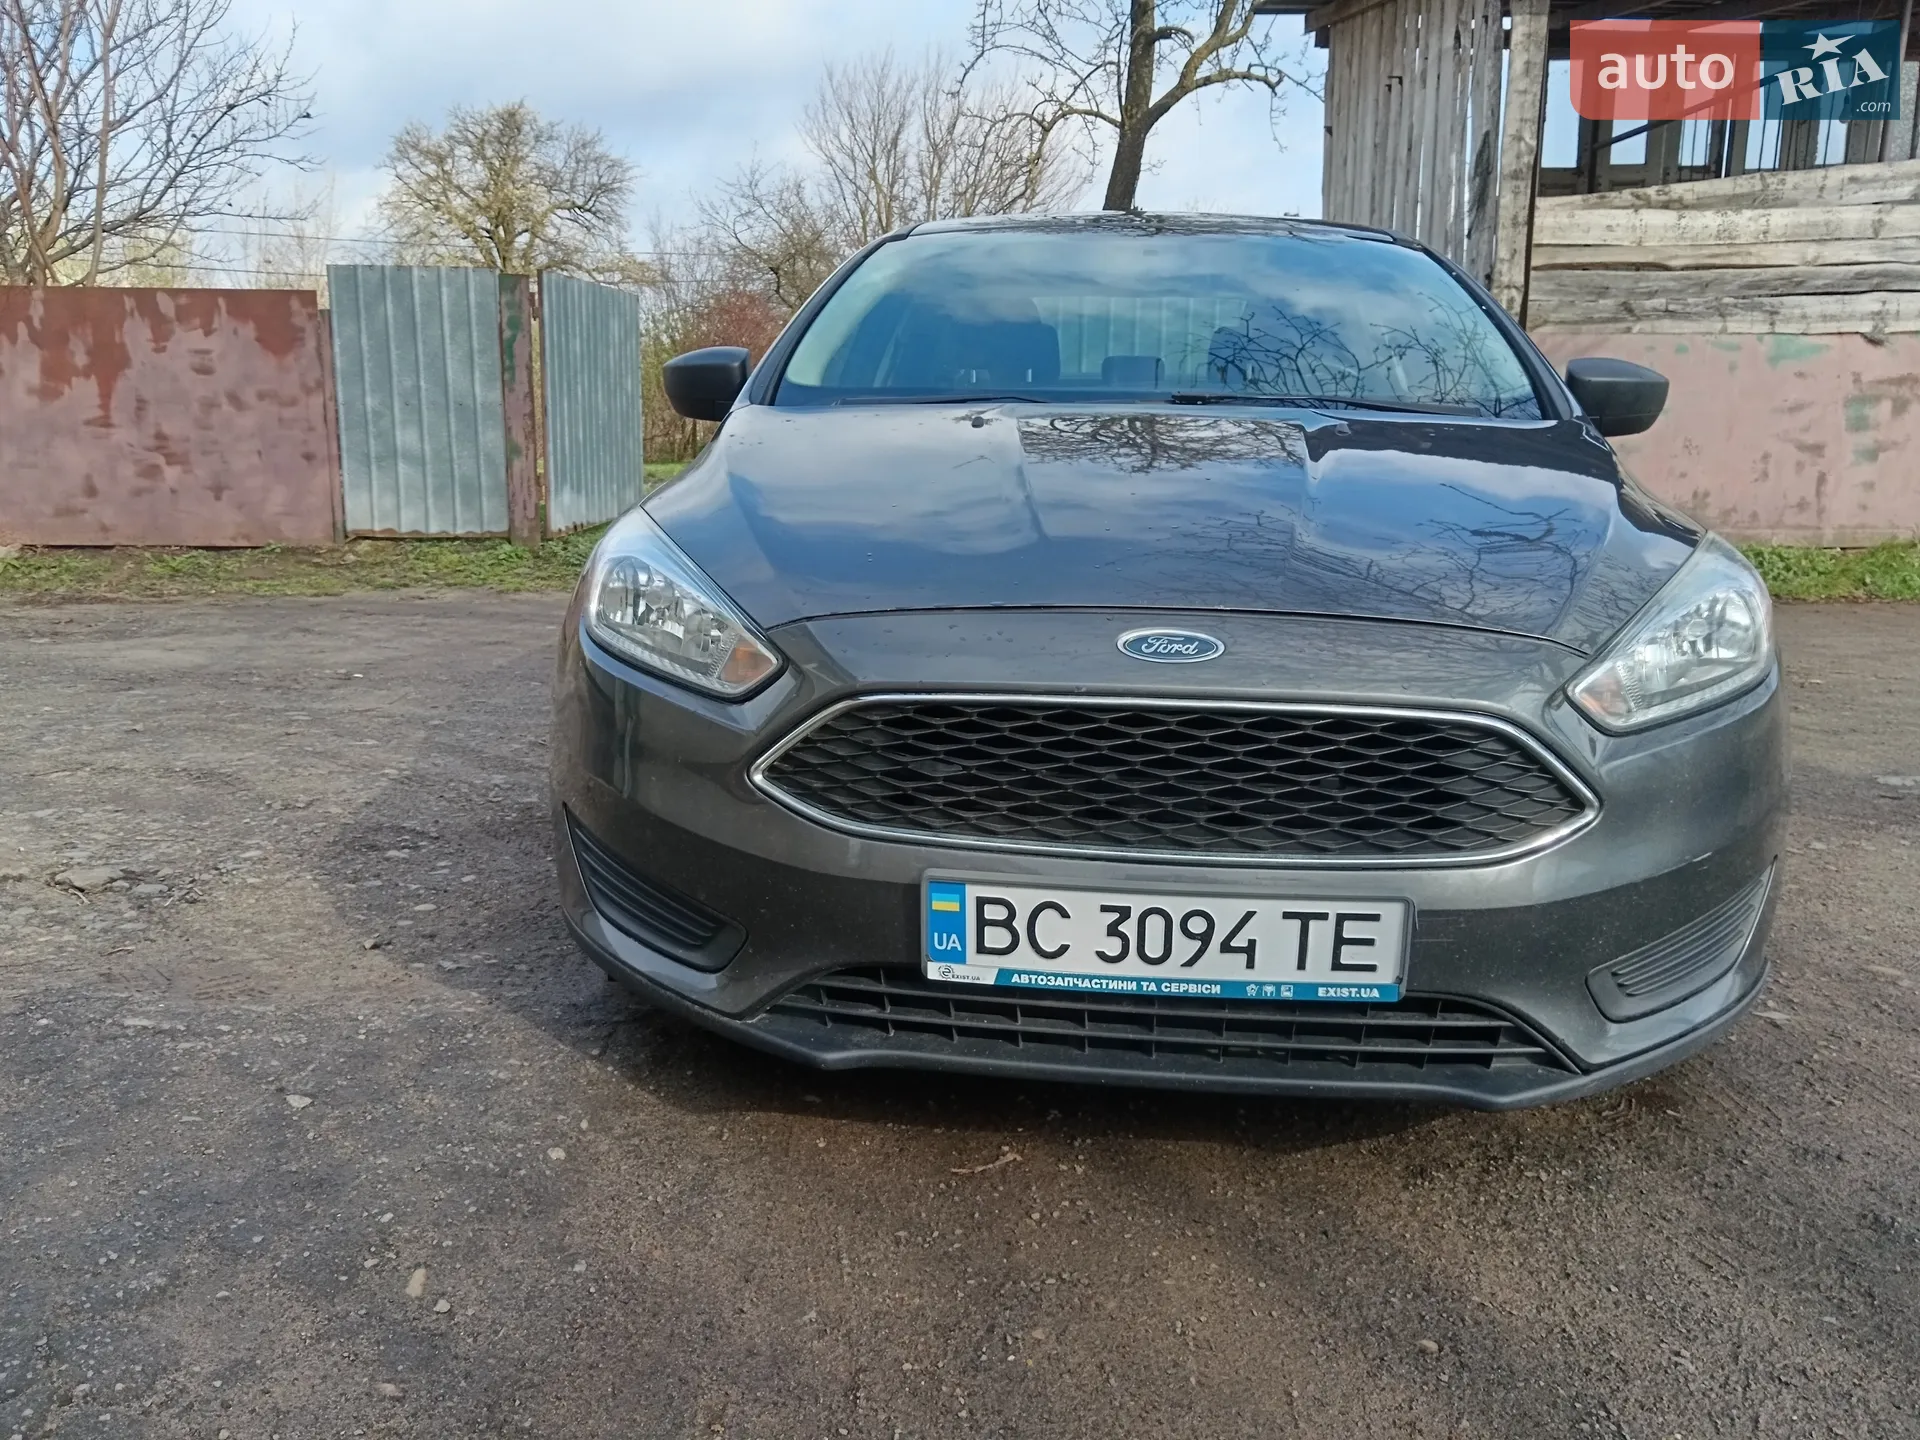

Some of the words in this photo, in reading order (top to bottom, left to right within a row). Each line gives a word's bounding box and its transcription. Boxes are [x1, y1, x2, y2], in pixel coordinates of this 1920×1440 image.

[1141, 636, 1199, 655] Ford
[933, 932, 962, 951] UA
[975, 895, 1071, 960] BC
[1095, 903, 1258, 970] 3094
[1282, 911, 1381, 972] TE
[1011, 972, 1137, 992] АВТОЗАПЧАСТИНИ
[1140, 981, 1157, 992] ТА
[1161, 982, 1221, 995] СЕРВІСИ
[1317, 986, 1380, 998] EXIST.UA
